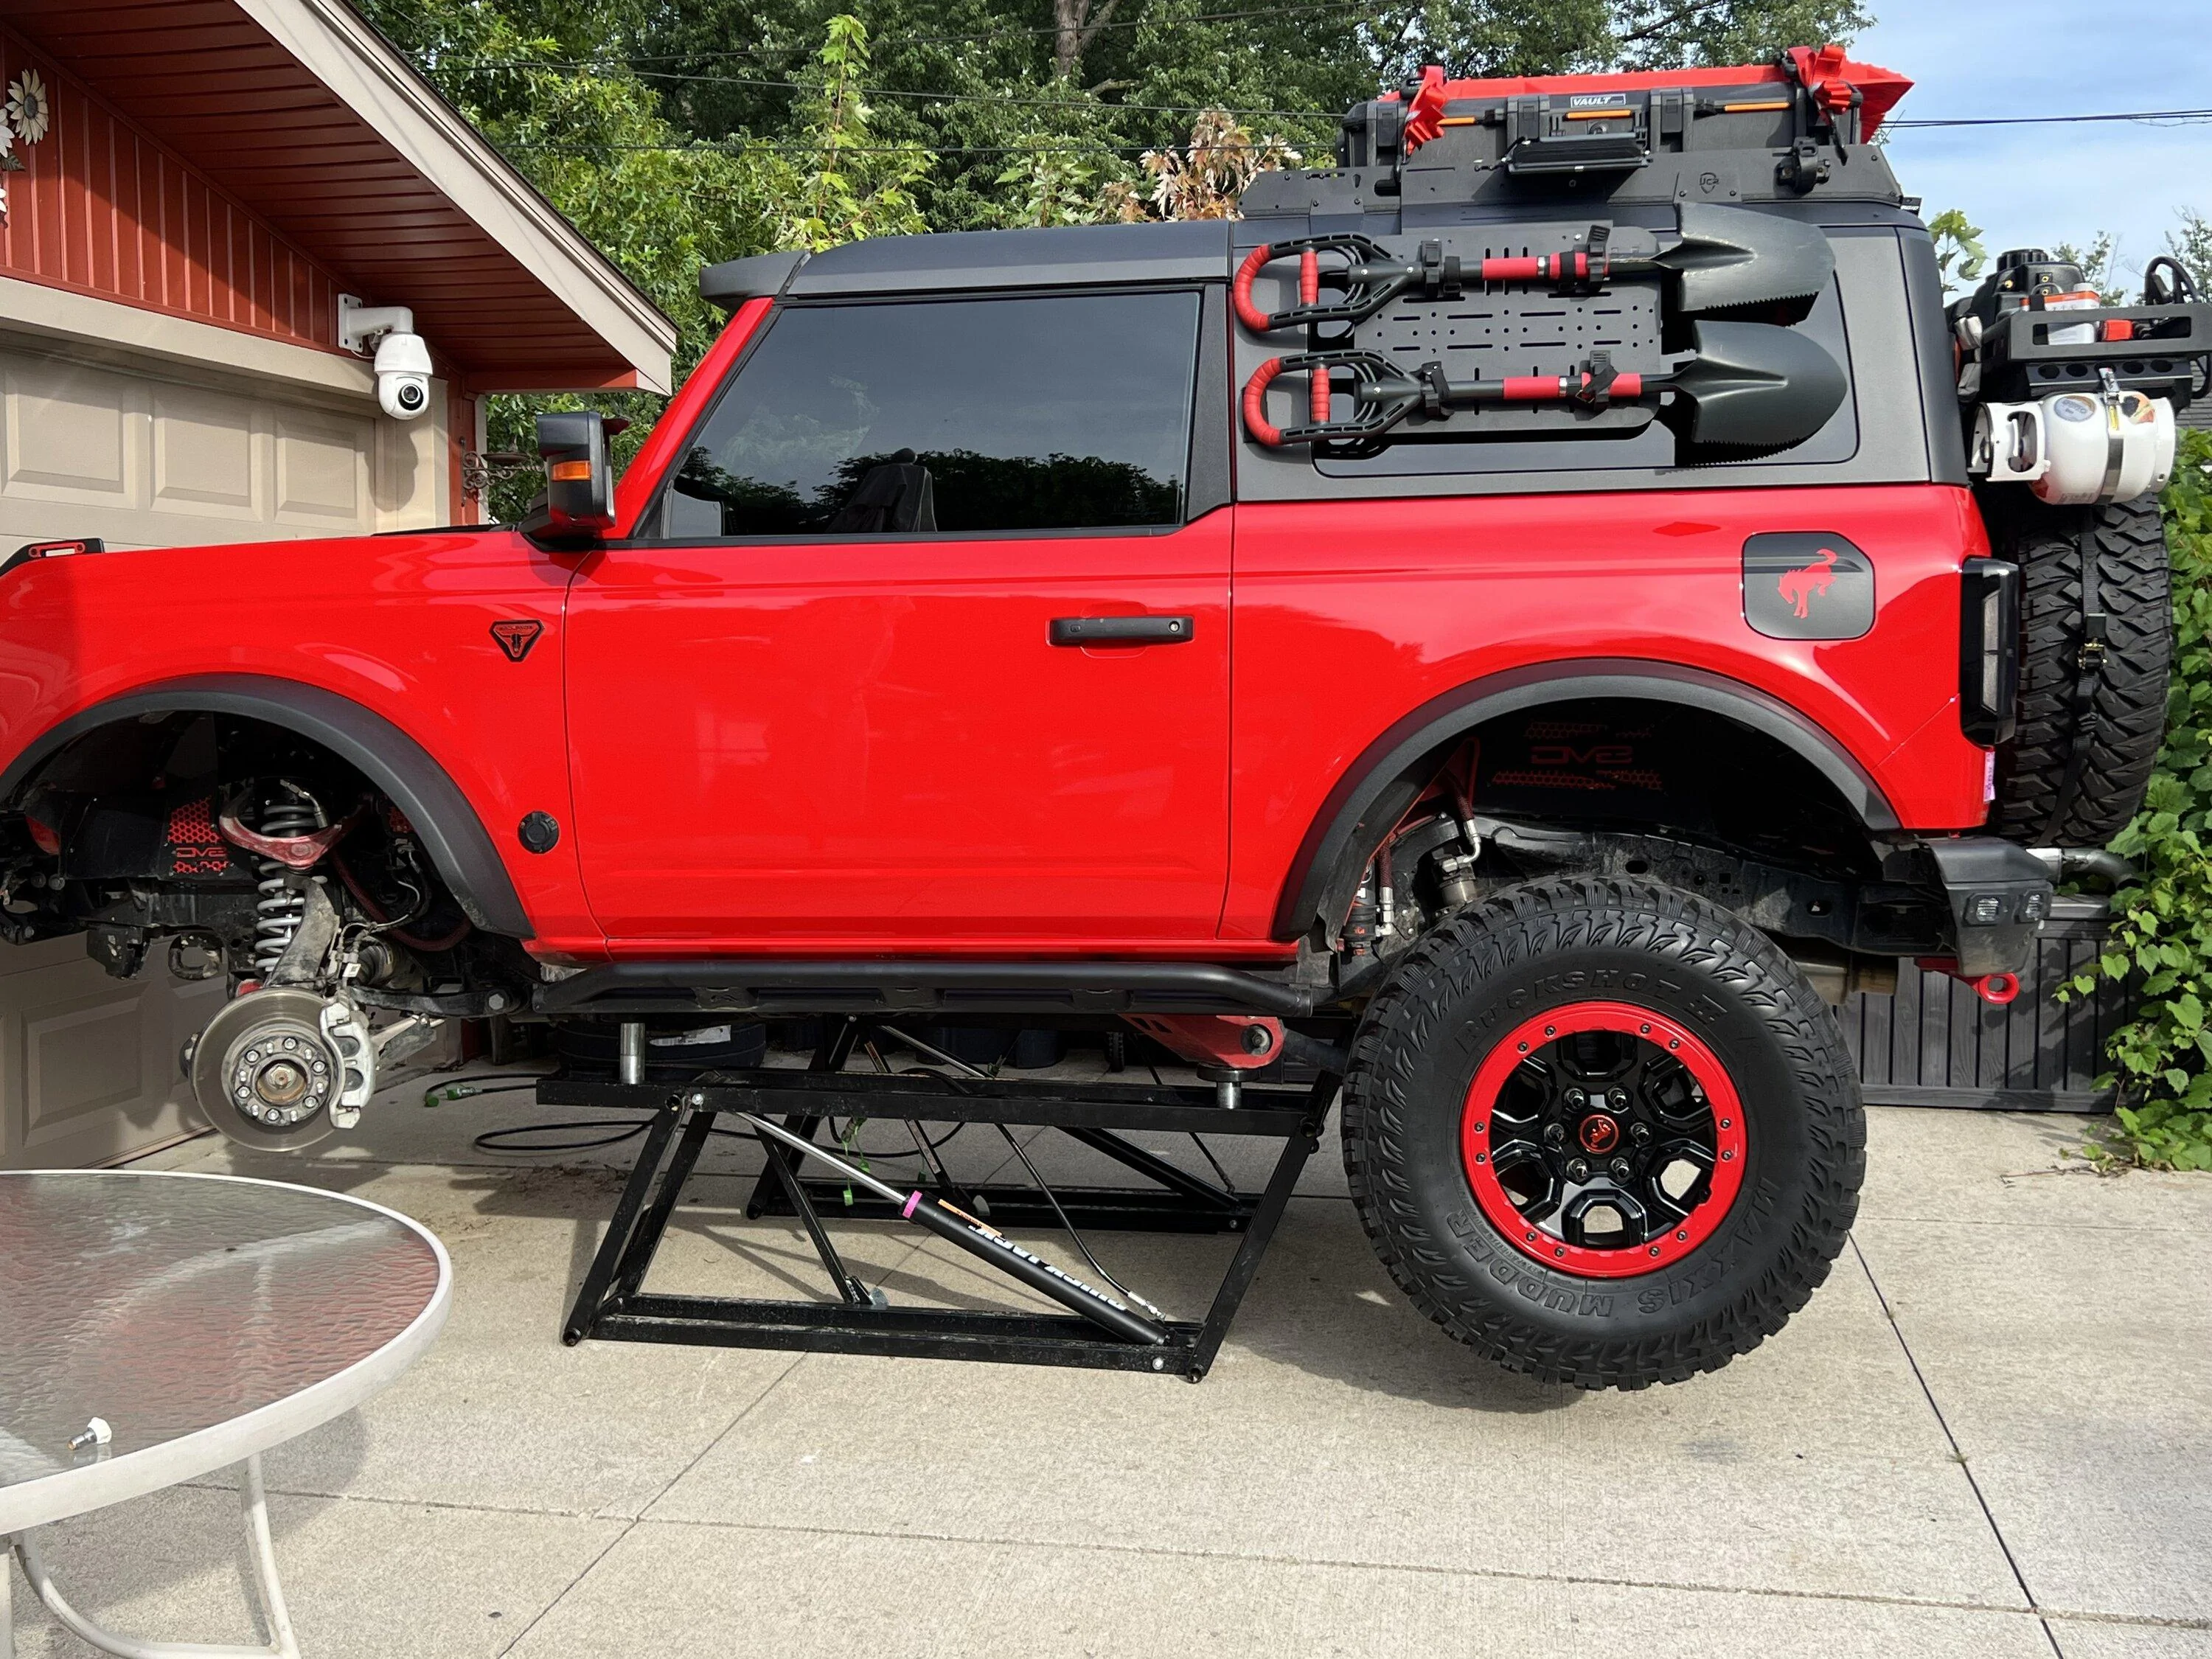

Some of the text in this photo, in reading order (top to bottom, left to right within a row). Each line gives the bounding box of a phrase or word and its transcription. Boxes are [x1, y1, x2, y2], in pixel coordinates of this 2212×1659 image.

[1573, 97, 1613, 107] VAULT
[1455, 969, 1682, 1055] BUCKSHOT
[1446, 1210, 1615, 1318] MUDDER
[1636, 1175, 1779, 1315] MAXXIS
